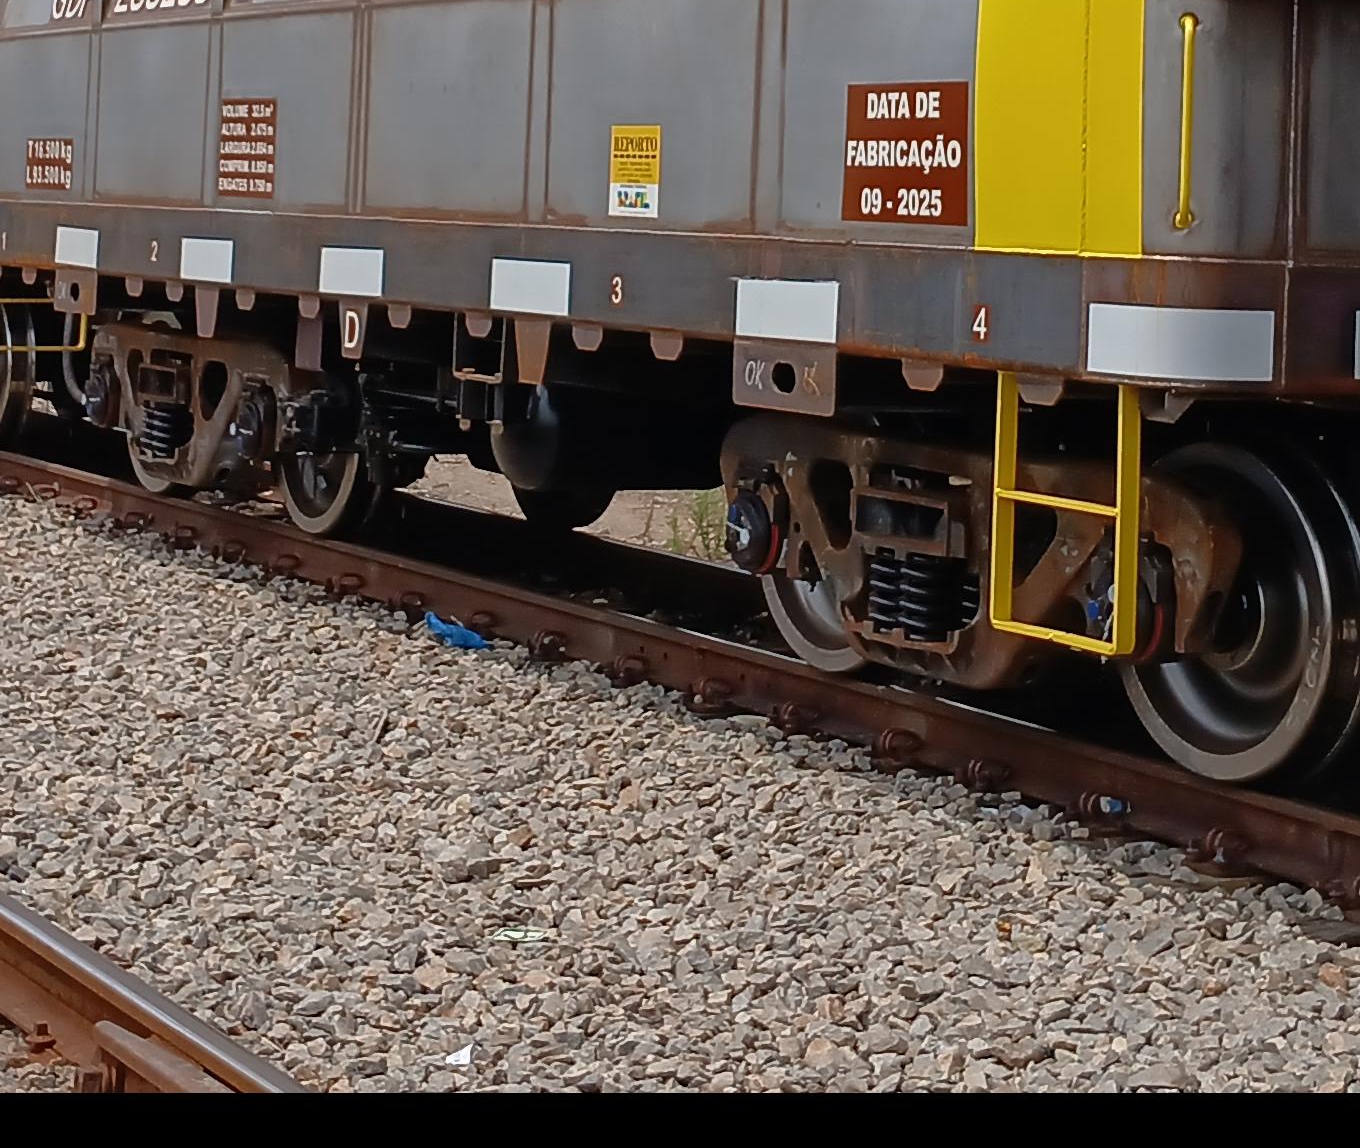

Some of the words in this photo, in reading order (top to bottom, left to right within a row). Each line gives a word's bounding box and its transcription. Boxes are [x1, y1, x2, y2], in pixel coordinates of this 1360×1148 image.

[866, 92, 910, 119] DATA
[915, 91, 940, 118] DE
[60, 140, 72, 164] kg
[846, 133, 962, 175] FABRICAÇÃO
[60, 165, 71, 189] kg
[861, 187, 882, 215] 09
[896, 188, 942, 217] 2025
[150, 240, 159, 262] 2
[611, 276, 623, 303] 3
[344, 310, 360, 348] D
[972, 307, 987, 339] 4
[745, 360, 766, 390] OK
